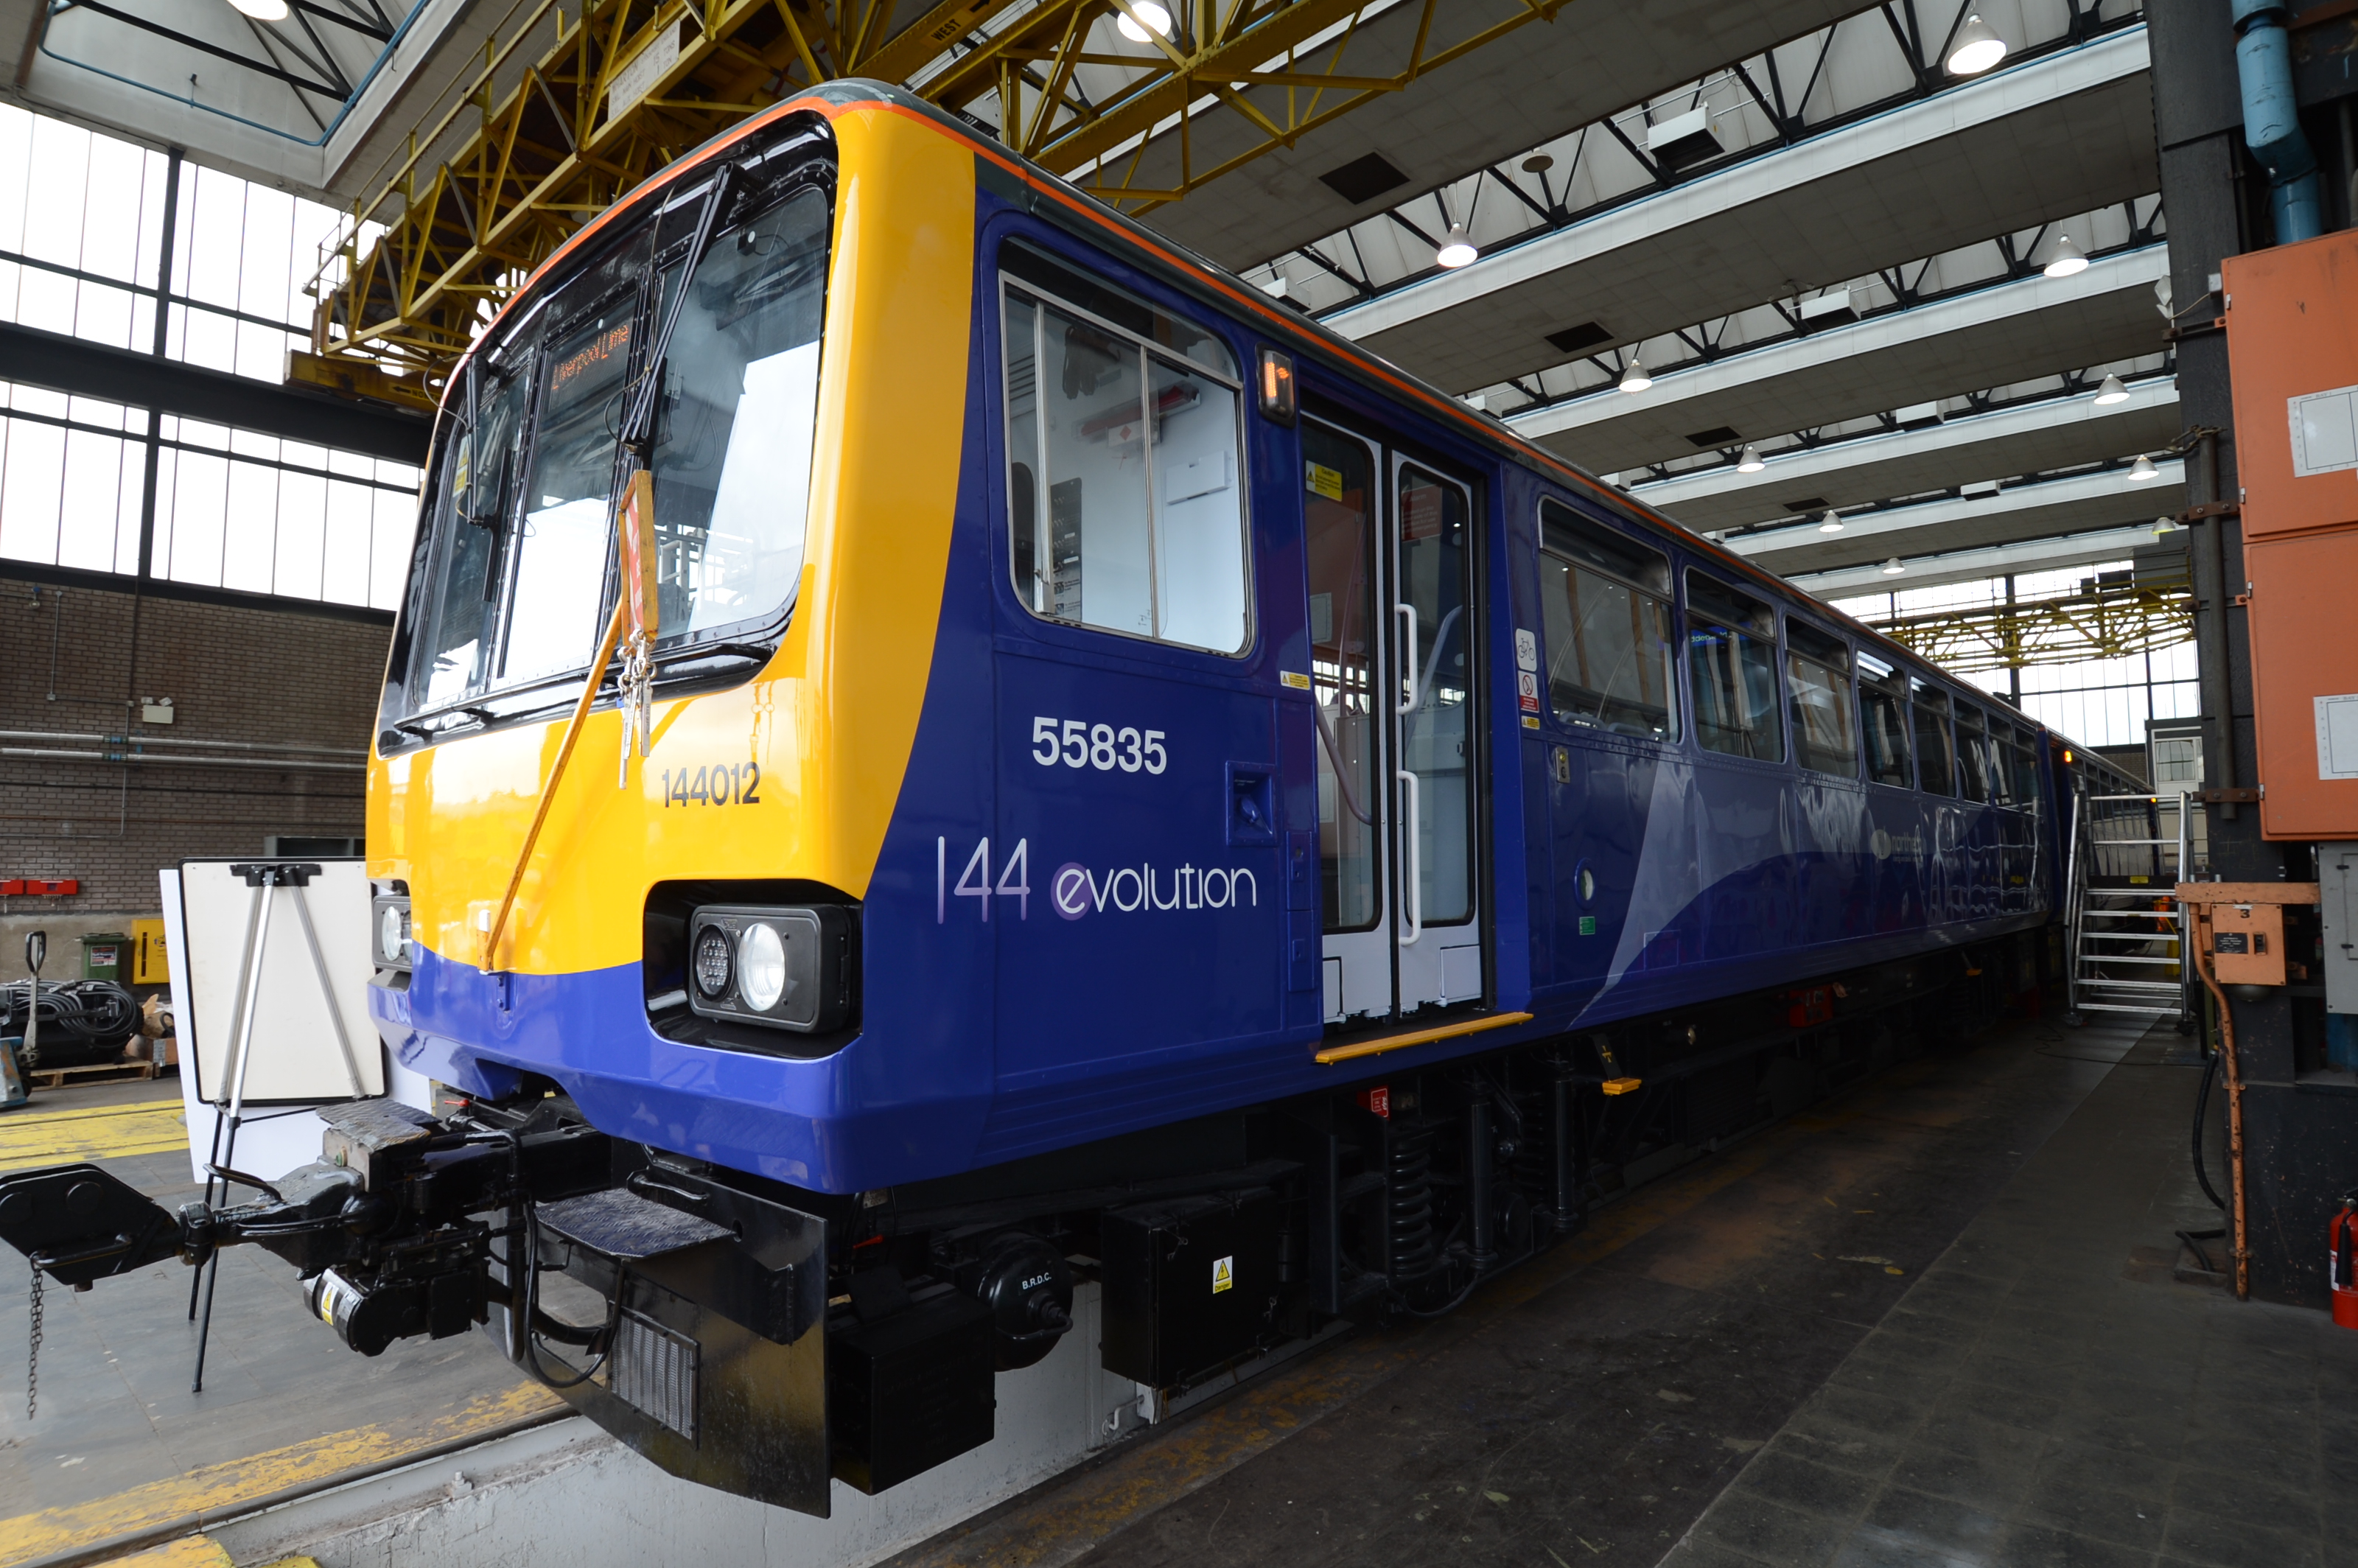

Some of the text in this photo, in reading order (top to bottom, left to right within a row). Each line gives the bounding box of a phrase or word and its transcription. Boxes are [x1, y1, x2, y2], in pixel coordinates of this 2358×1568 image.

[931, 18, 961, 41] WEST
[1032, 716, 1167, 775] 55835
[662, 761, 760, 808] 144012
[937, 836, 1257, 925] 144 evolution
[2240, 909, 2250, 918] 3
[1021, 1272, 1052, 1290] B.R.D.C.
